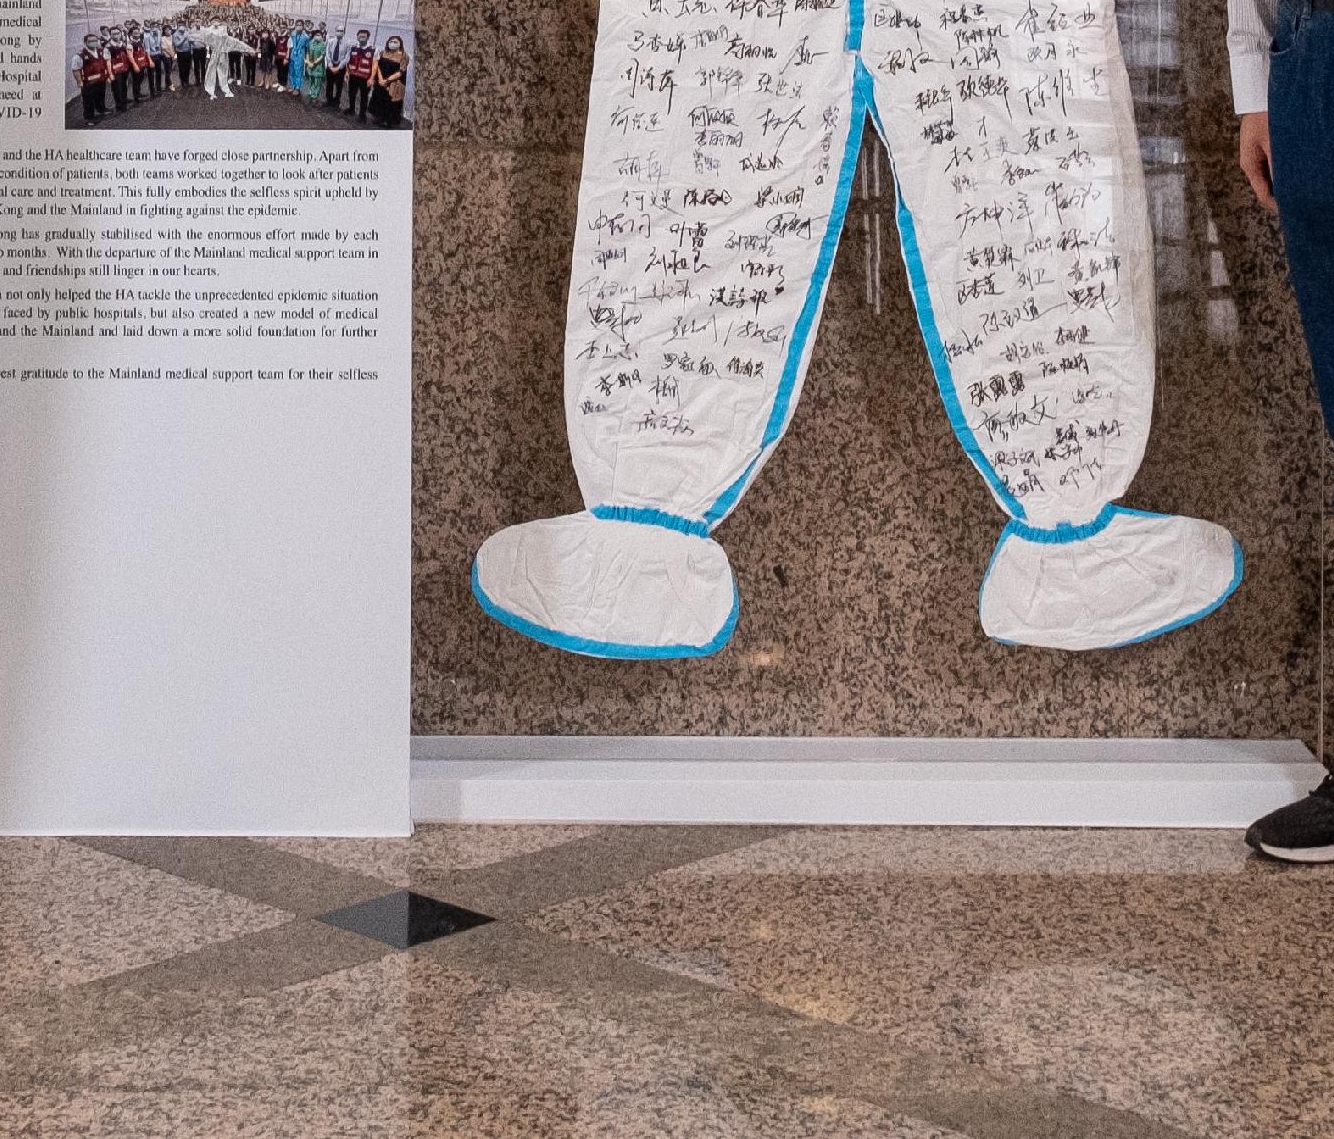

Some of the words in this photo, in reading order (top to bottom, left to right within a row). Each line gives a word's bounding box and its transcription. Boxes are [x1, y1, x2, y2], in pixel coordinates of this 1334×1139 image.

[3, 148, 23, 160] and
[26, 148, 41, 160] the
[45, 148, 63, 160] HA
[66, 148, 122, 160] healthcare
[126, 148, 151, 160] team
[154, 148, 179, 160] have
[183, 148, 218, 163] forged
[222, 148, 249, 160] close
[320, 148, 349, 163] Apart
[354, 148, 378, 160] from
